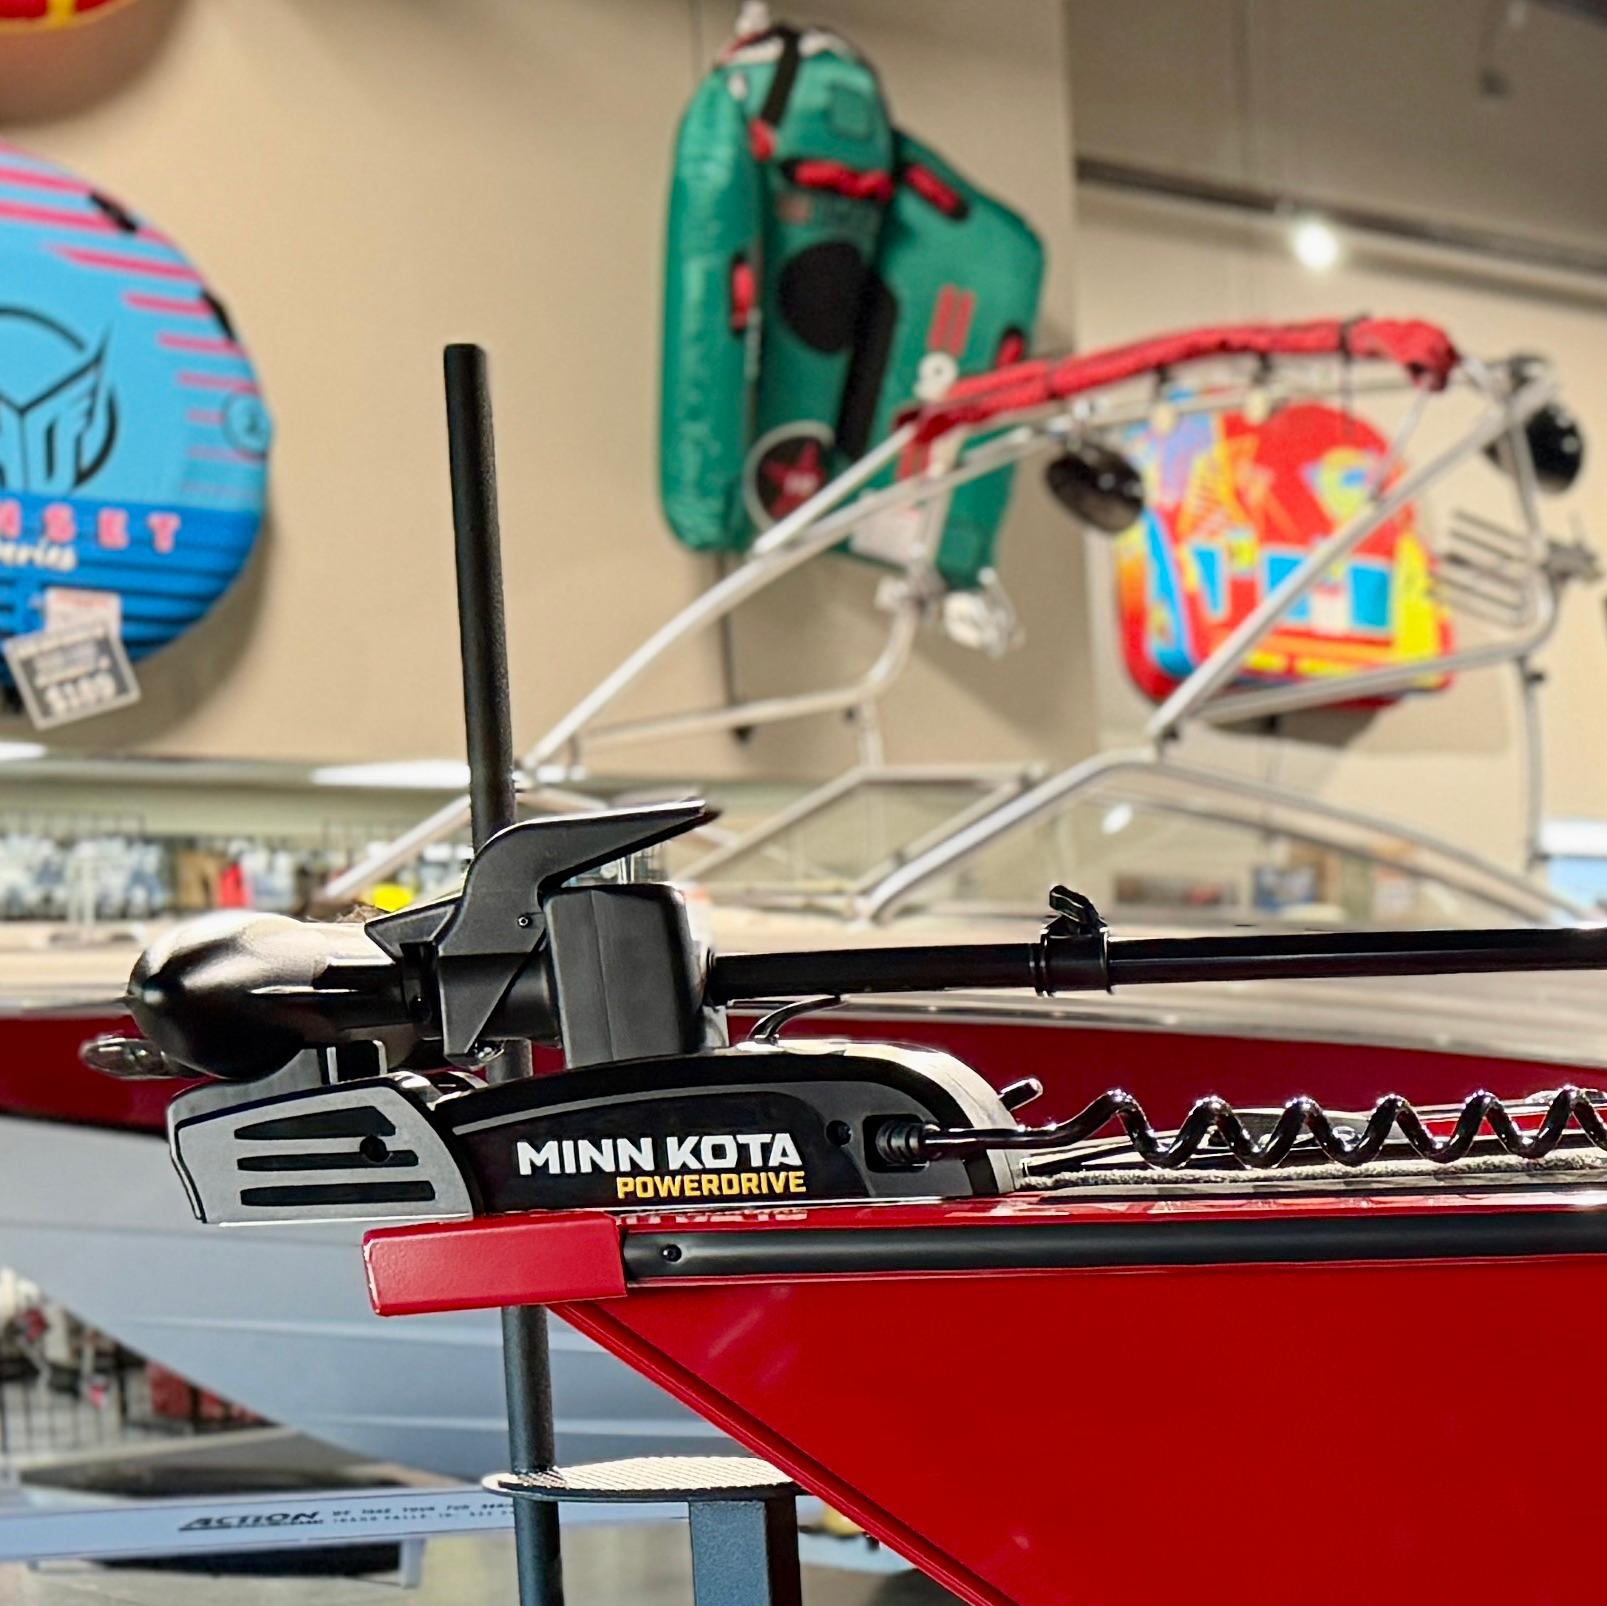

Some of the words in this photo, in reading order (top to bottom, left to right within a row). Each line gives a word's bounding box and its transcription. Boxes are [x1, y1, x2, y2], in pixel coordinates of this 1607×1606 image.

[516, 1136, 656, 1175] MINN
[666, 1133, 803, 1170] KOTA
[616, 1170, 807, 1199] POWERDRIVE
[178, 1511, 320, 1531] ACTION
